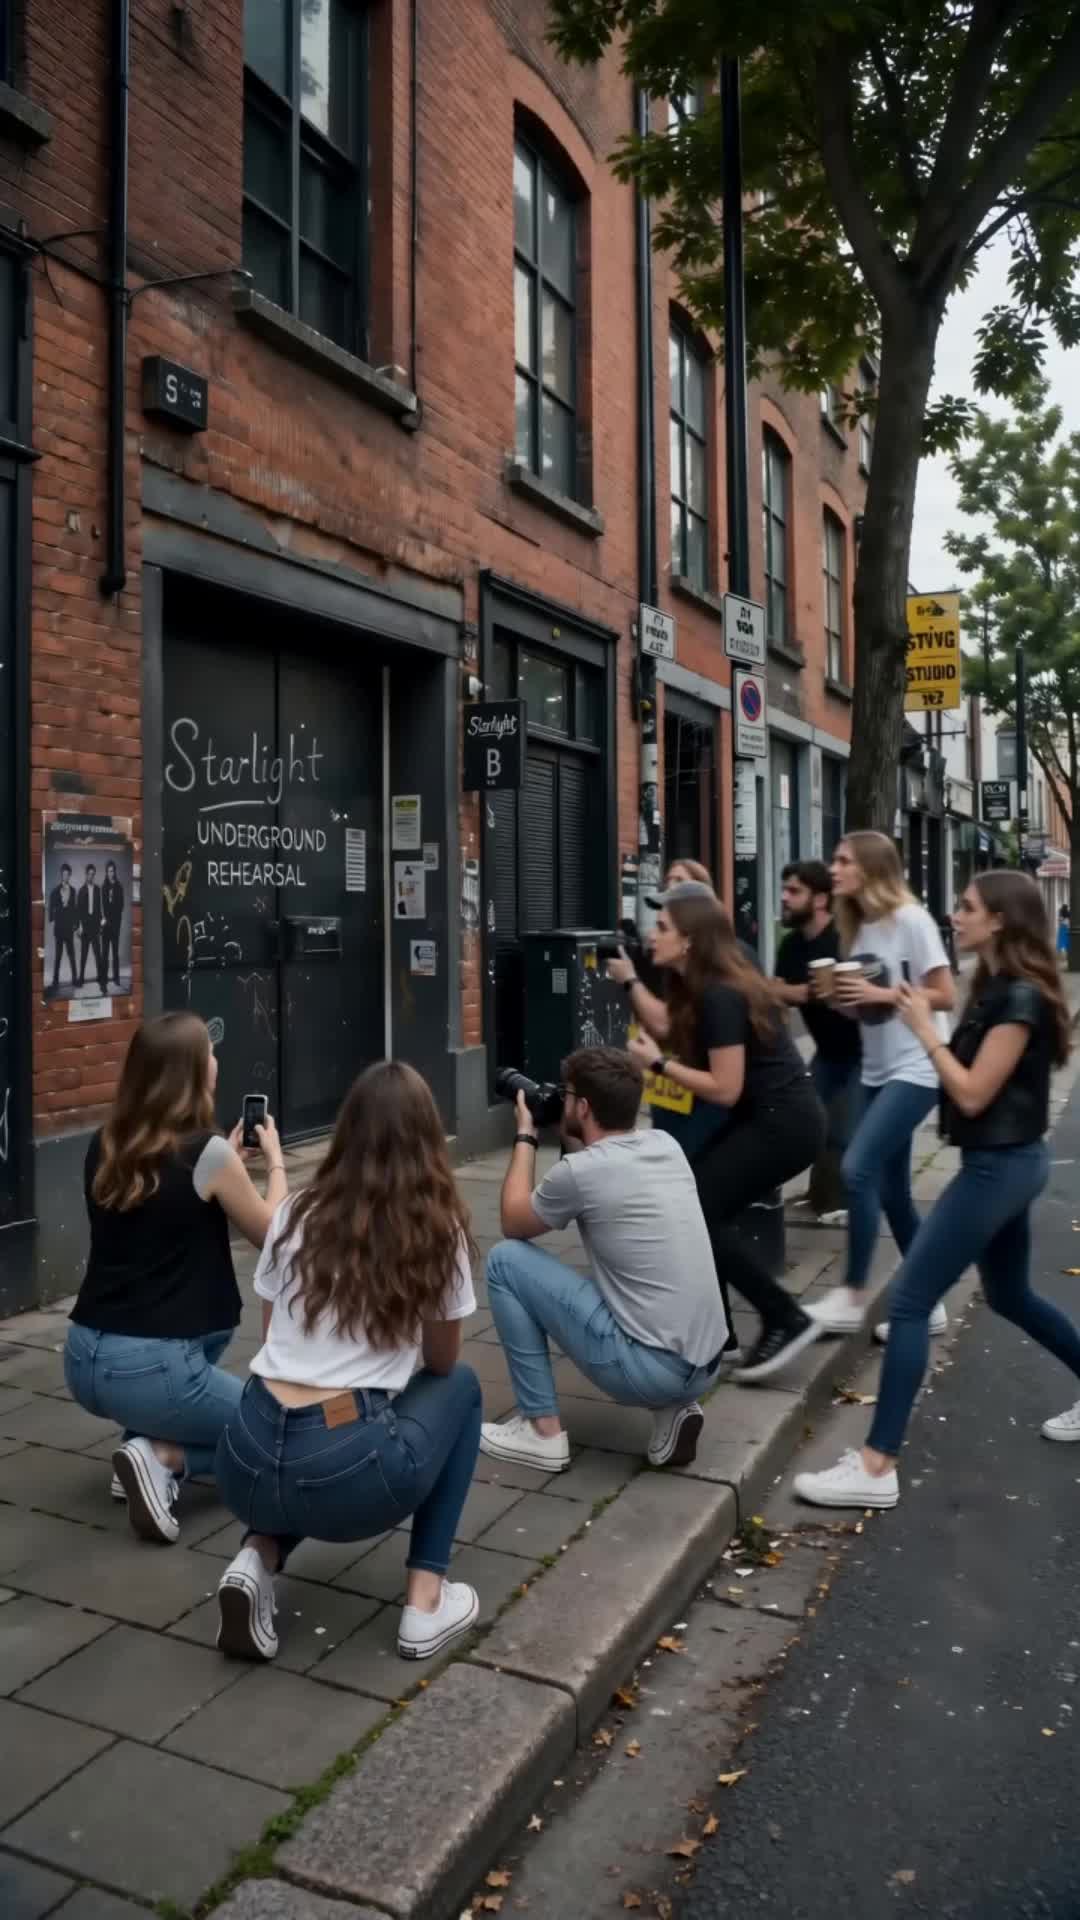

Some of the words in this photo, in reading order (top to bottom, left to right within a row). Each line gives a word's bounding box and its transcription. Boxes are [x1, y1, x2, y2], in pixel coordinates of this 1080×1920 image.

[165, 717, 325, 804] Starlight
[487, 749, 501, 777] B
[197, 821, 327, 852] UNDERGROUND
[207, 861, 307, 886] REHEARSAL
